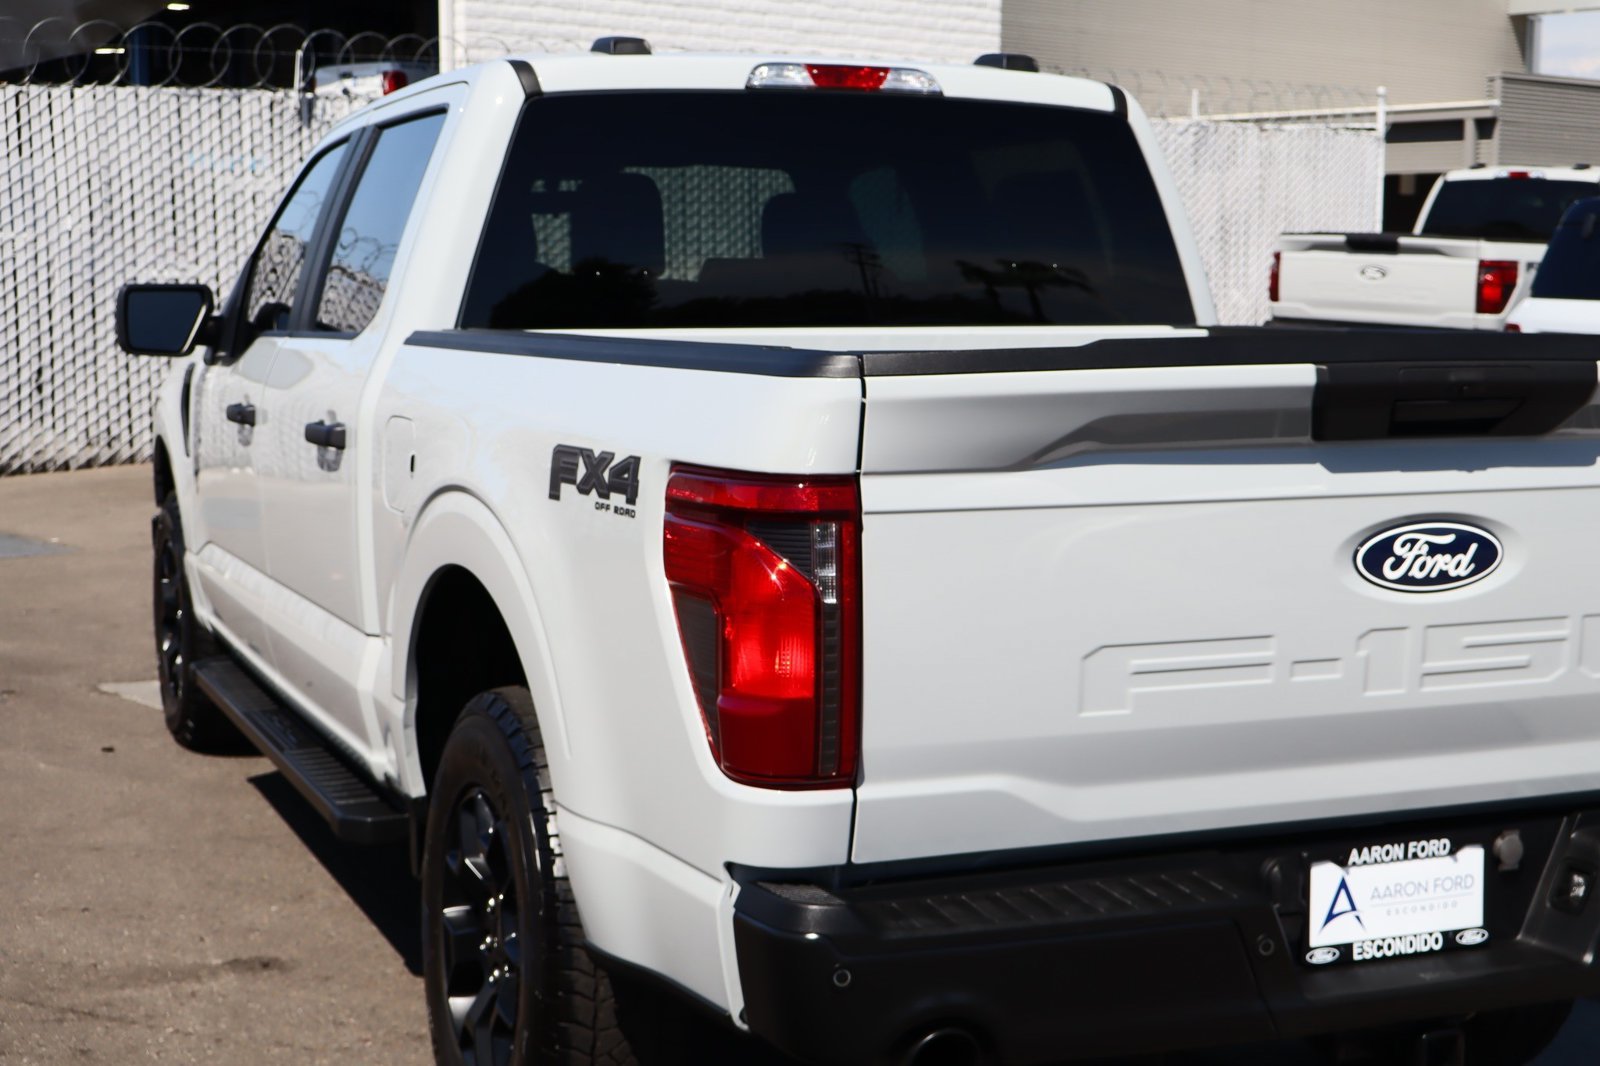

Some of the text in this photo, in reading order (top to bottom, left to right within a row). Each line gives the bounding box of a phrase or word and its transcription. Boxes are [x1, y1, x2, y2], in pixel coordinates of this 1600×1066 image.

[549, 444, 641, 506] FX4
[594, 502, 636, 519] OFF ROAD
[1382, 532, 1479, 581] Ford
[1079, 614, 1600, 717] F-15
[1348, 838, 1451, 866] AARON FORD
[1370, 873, 1474, 900] AARON FORD
[1352, 932, 1444, 961] ESCONDIDO
